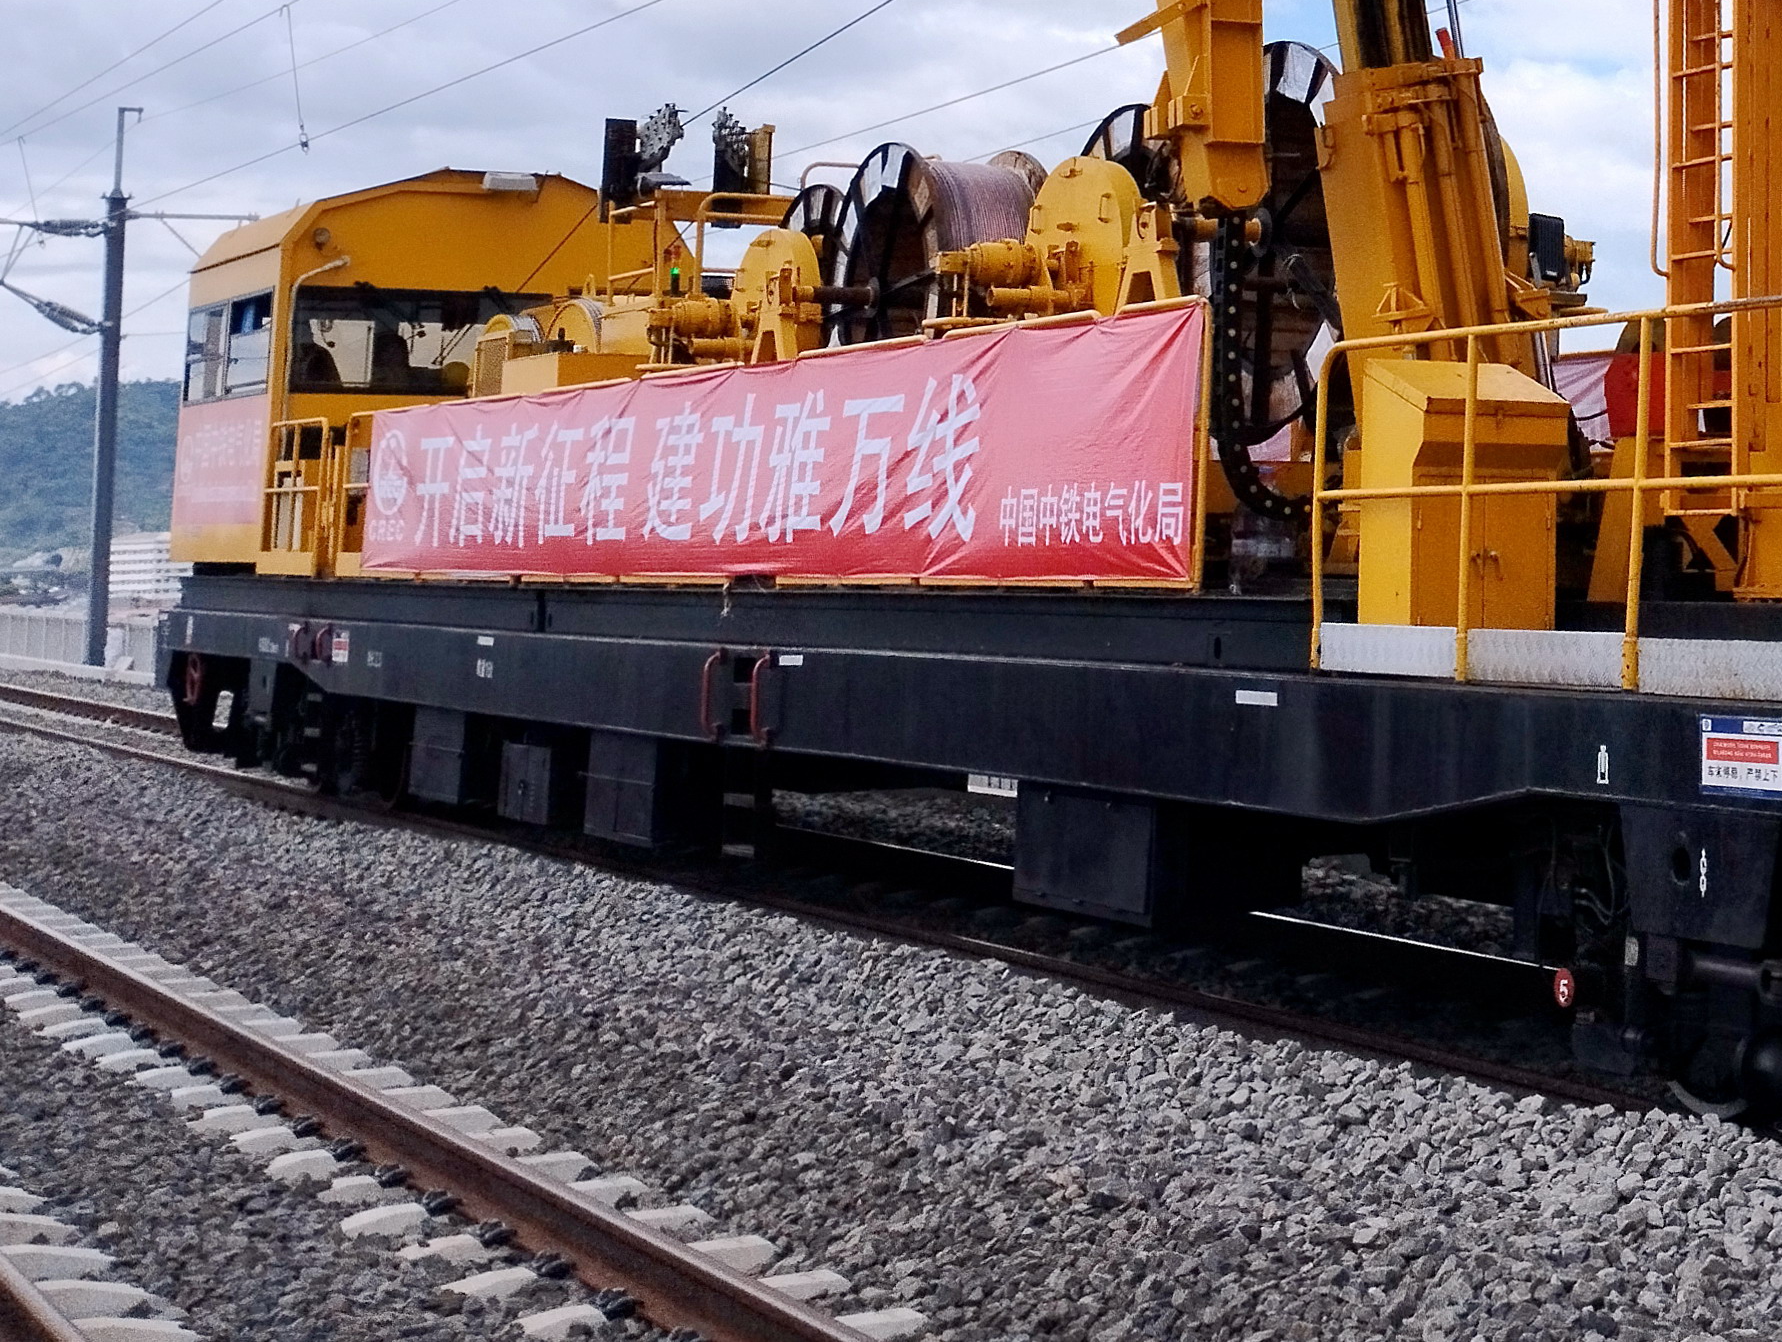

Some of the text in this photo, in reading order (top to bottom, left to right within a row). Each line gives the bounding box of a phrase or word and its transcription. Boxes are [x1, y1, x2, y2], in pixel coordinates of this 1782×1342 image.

[414, 372, 983, 548] 开启新征程 建功雅万线
[368, 519, 405, 542] CREC
[999, 480, 1185, 548] 中国中铁电气化局
[1559, 979, 1569, 1003] 5
